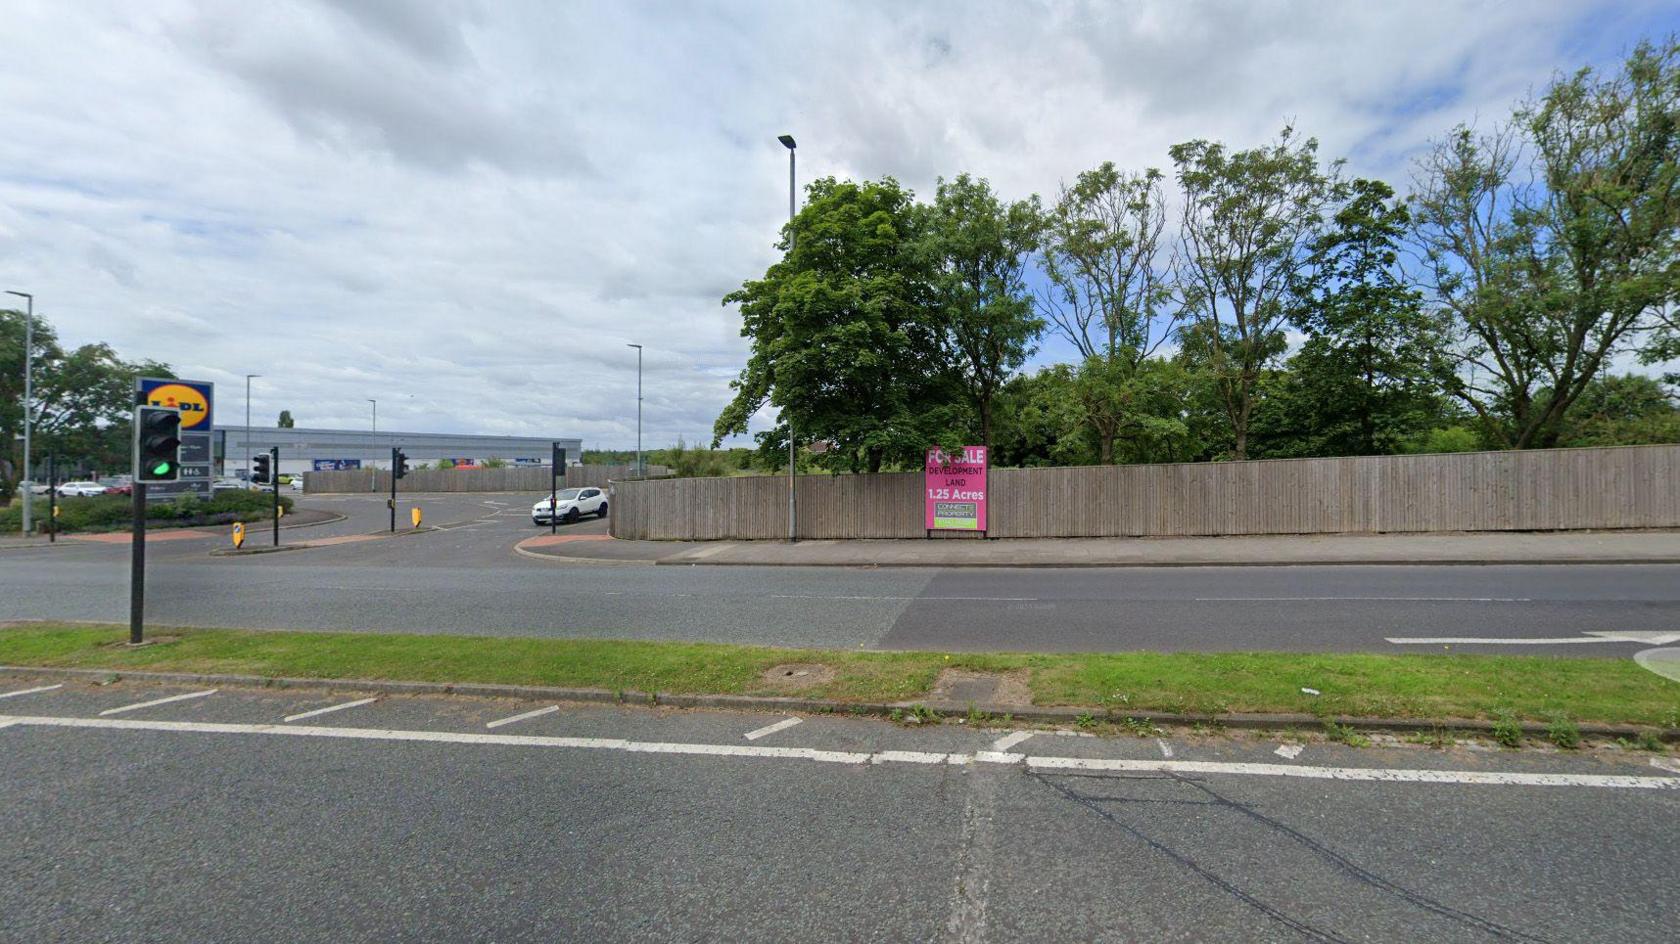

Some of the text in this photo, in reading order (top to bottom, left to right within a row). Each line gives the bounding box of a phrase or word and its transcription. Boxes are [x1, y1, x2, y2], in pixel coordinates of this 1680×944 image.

[928, 450, 951, 464] FOR
[928, 467, 983, 475] DEVELOPMENT
[945, 479, 966, 487] LAND
[928, 489, 984, 500] 1.25 Acres
